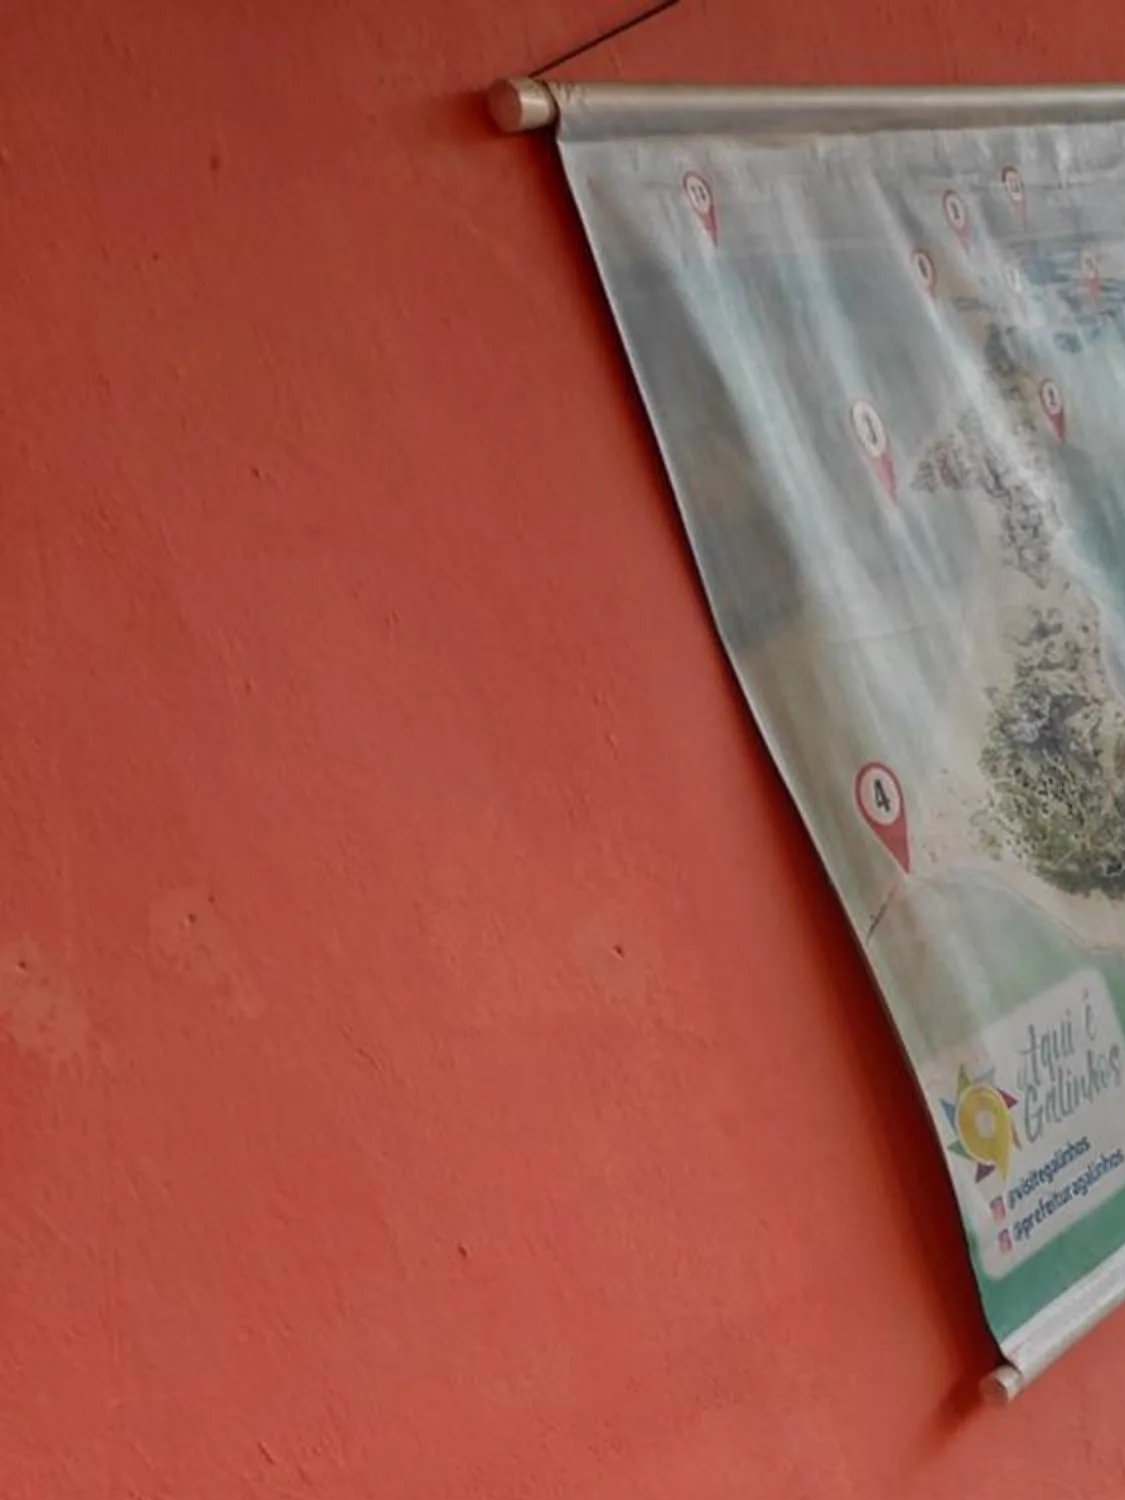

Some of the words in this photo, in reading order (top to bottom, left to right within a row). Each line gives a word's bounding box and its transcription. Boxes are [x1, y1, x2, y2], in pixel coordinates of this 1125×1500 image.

[873, 778, 890, 813] 4
[1023, 1044, 1121, 1144] Galinhos
[1007, 1136, 1092, 1210] @visitegalinhos
[1012, 1148, 1125, 1241] @prefeituragalinhos
